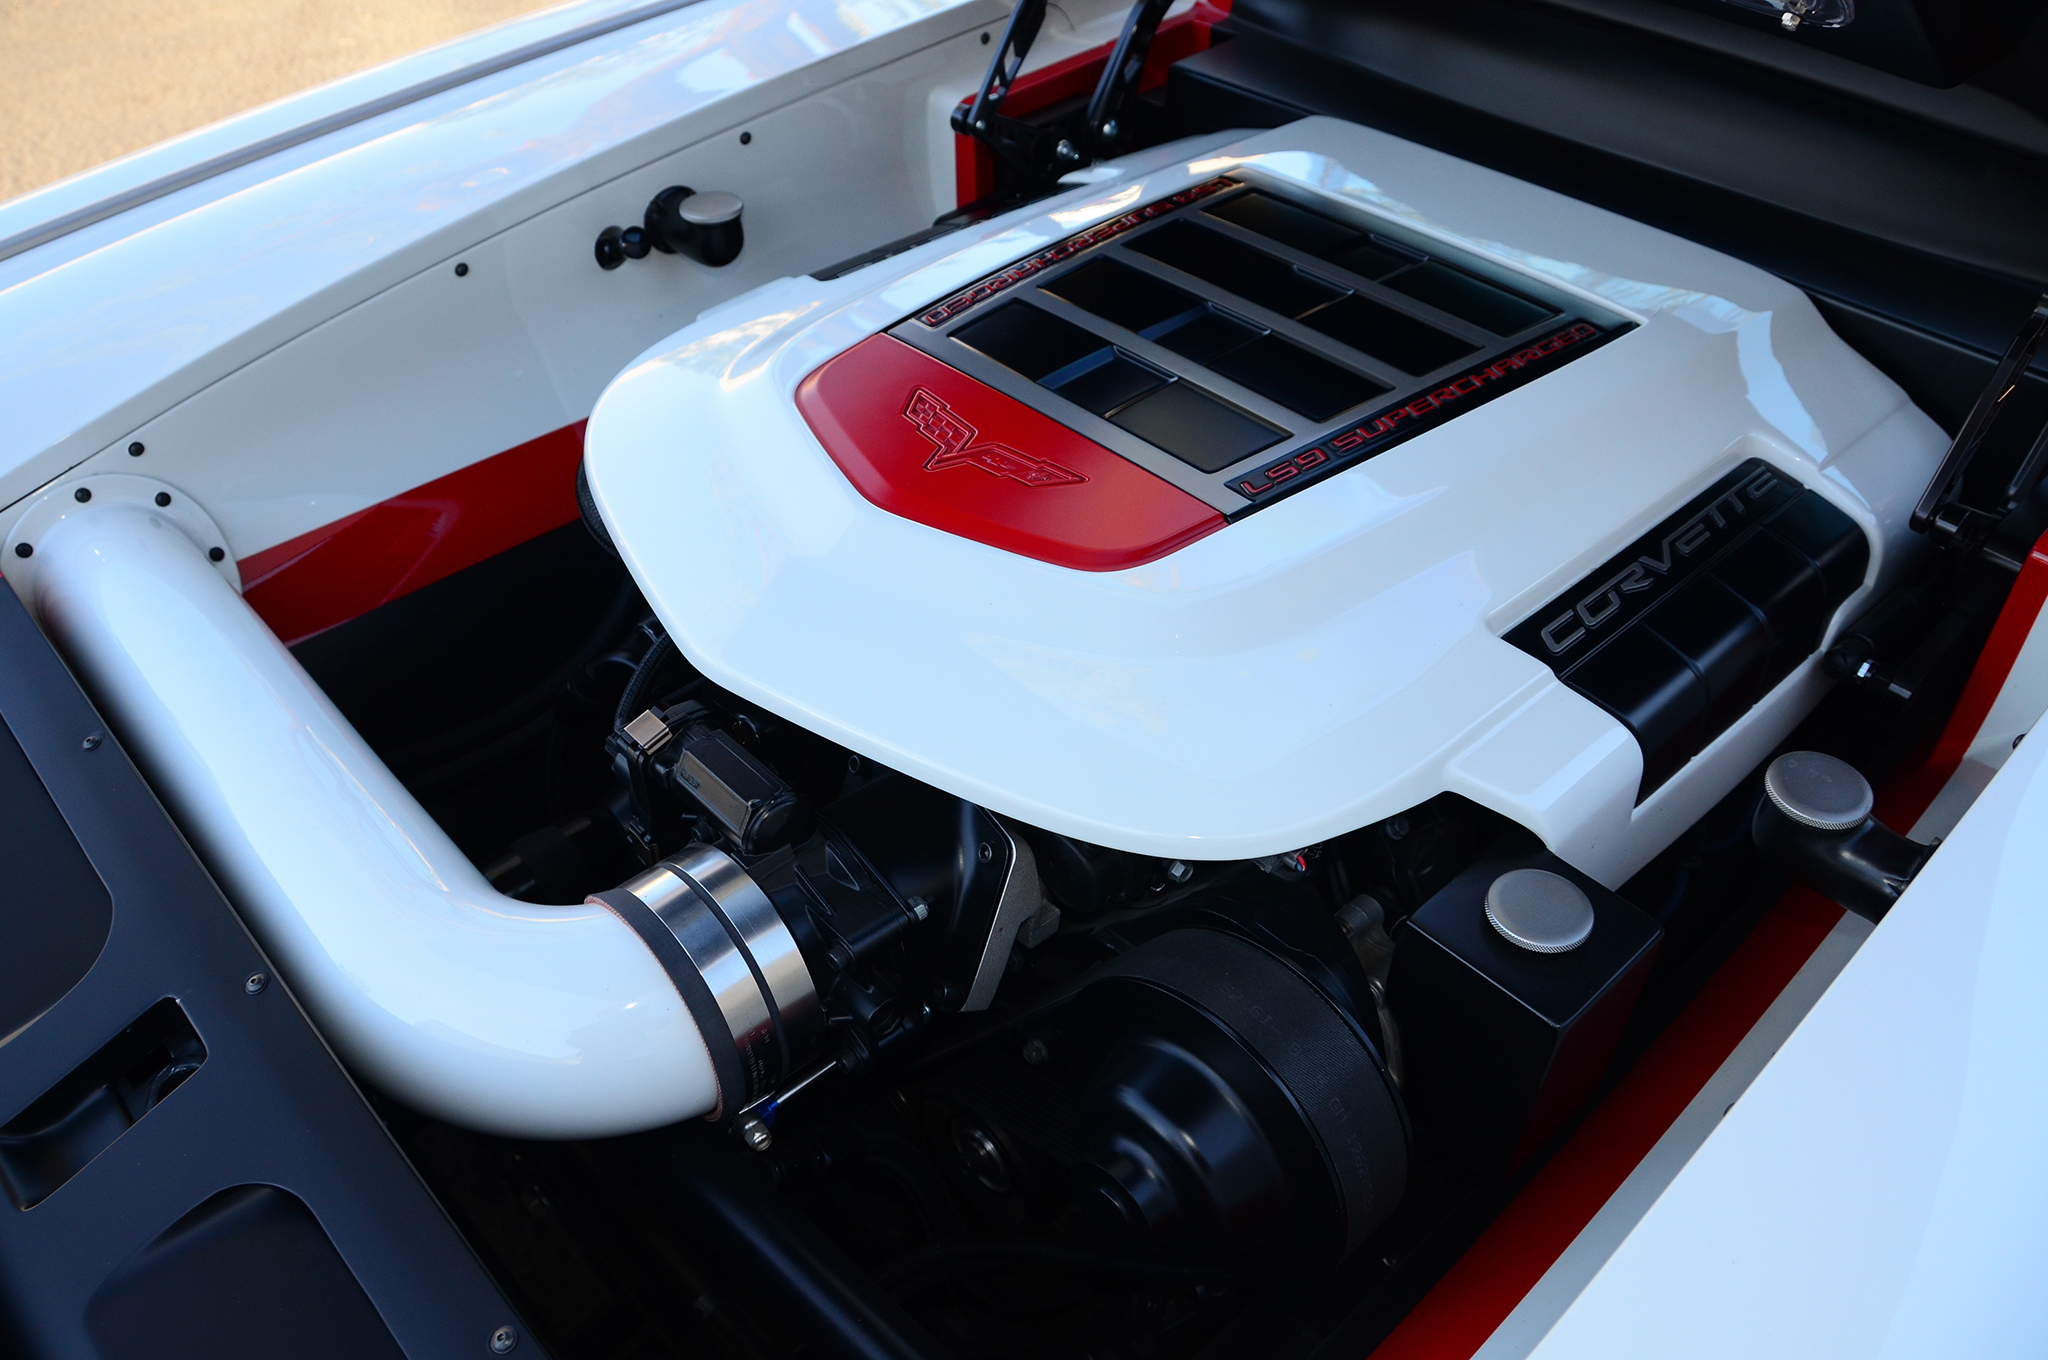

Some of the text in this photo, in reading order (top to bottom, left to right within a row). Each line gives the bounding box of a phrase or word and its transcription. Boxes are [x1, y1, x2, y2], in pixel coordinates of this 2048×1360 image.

[925, 201, 1173, 326] SUPERCHARGED
[1240, 323, 1597, 496] LS9 SUPERCHARGED
[1540, 465, 1779, 655] CORVETTE
